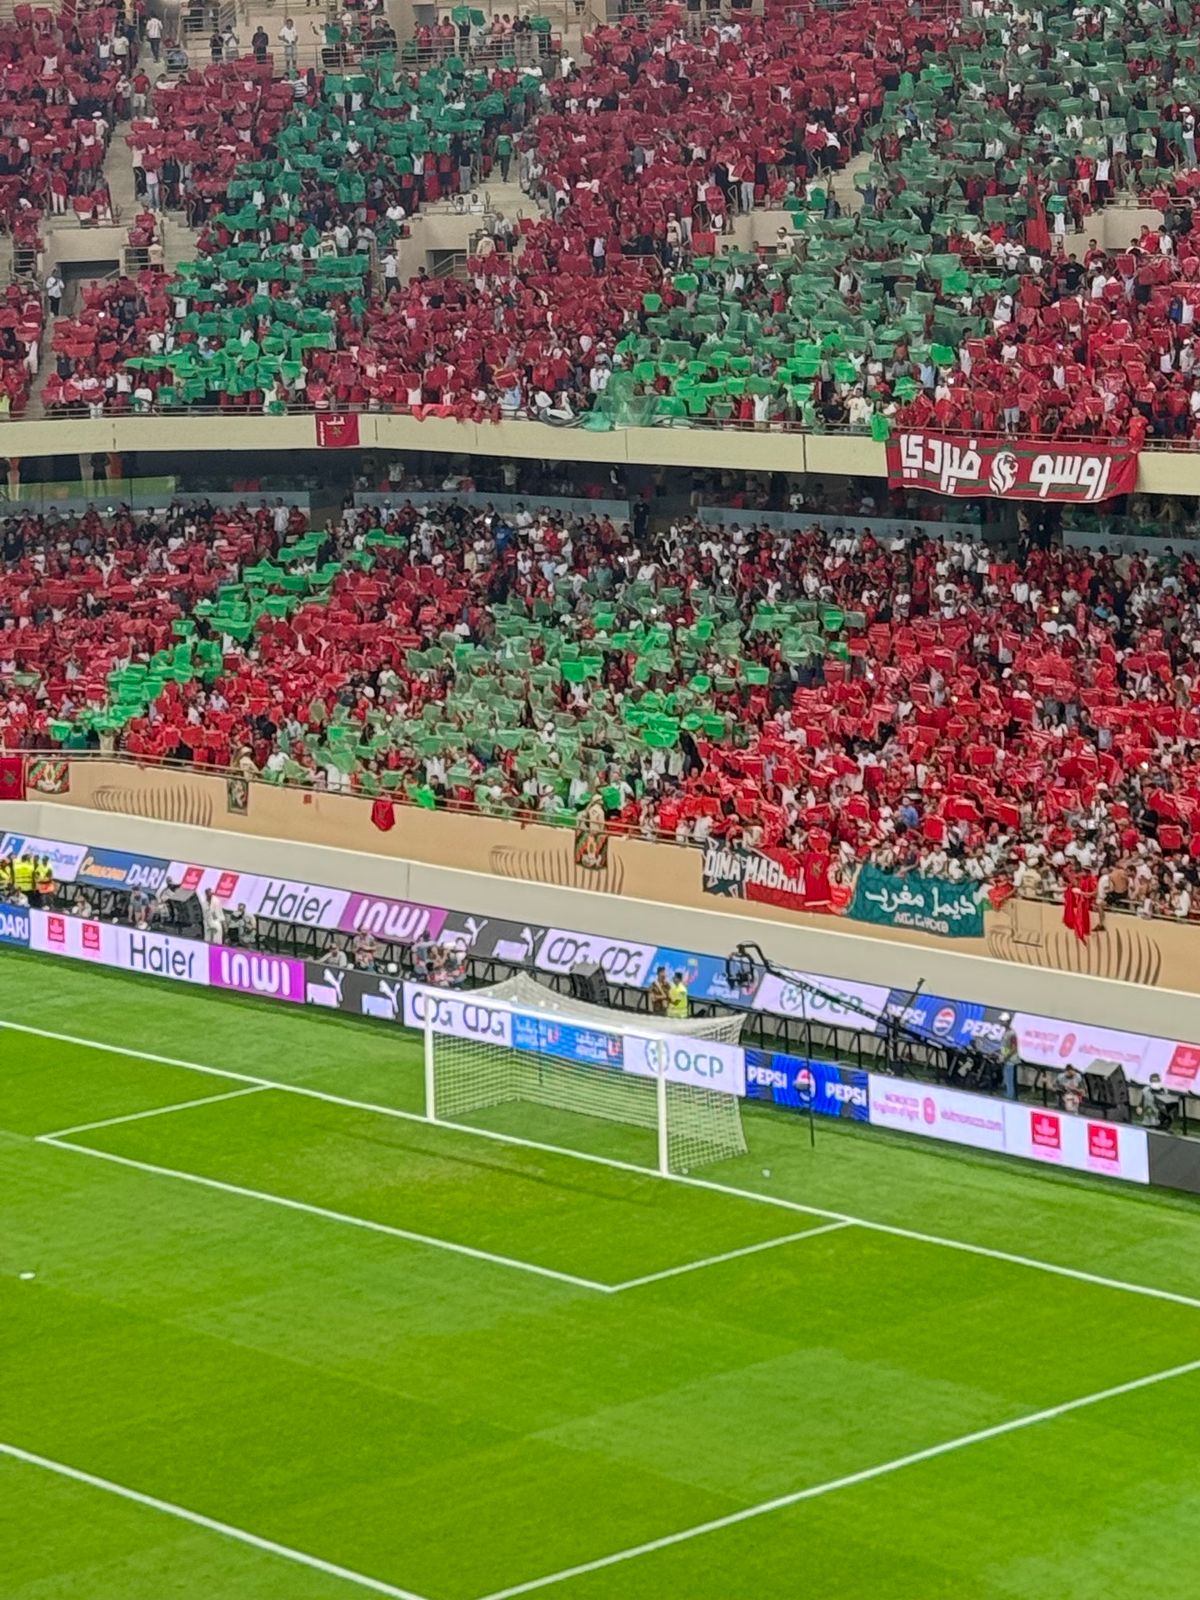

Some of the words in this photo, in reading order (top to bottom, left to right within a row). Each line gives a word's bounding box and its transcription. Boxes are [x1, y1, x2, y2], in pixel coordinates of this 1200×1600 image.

[128, 864, 166, 890] DARI
[258, 881, 333, 924] Haier
[129, 932, 195, 979] Haier
[960, 1018, 1007, 1042] PEPSI
[673, 1049, 724, 1079] OCP
[747, 1064, 788, 1090] PEPSI
[824, 1081, 867, 1107] PEPSI
